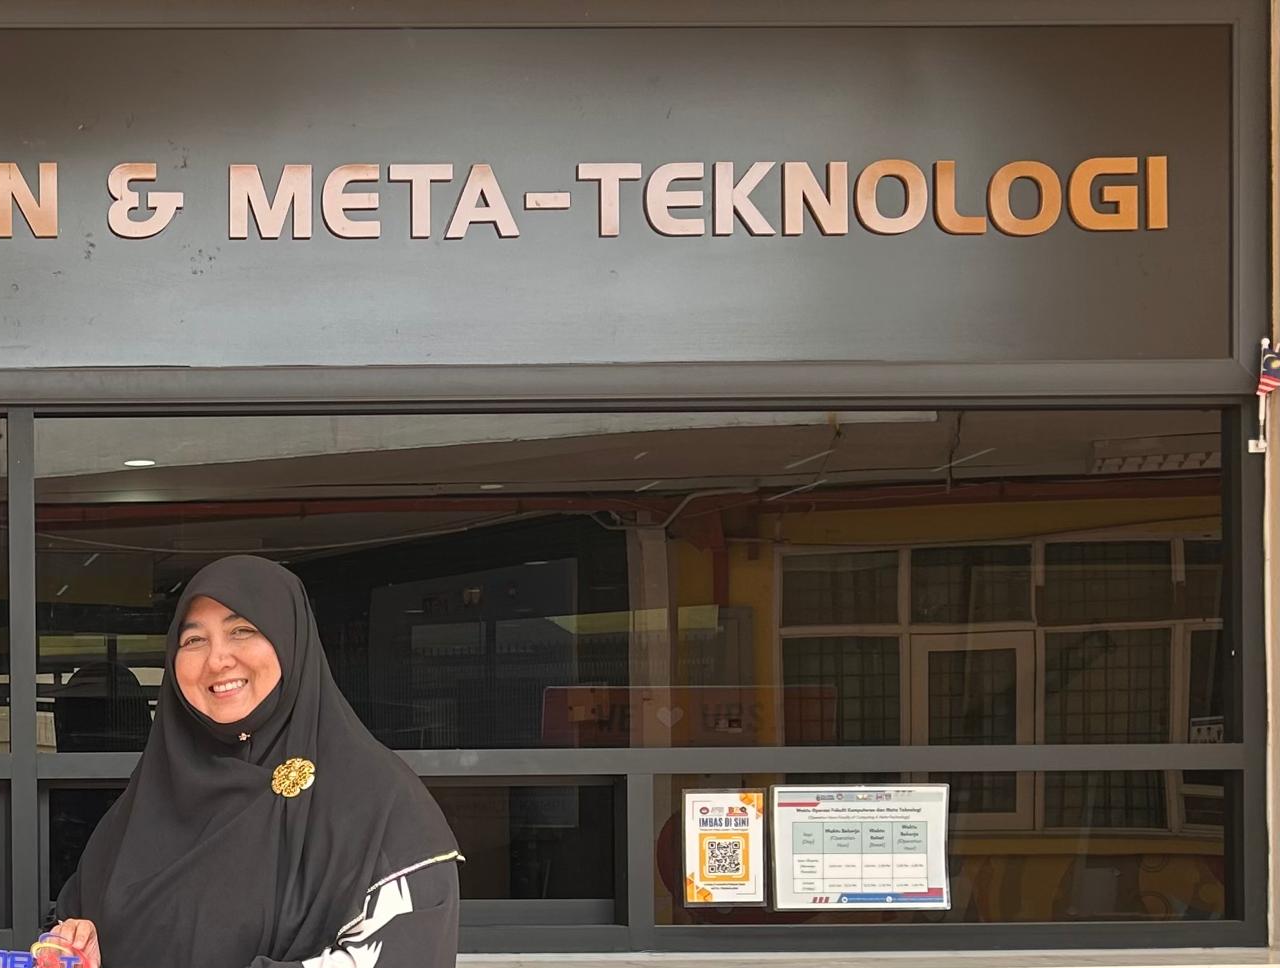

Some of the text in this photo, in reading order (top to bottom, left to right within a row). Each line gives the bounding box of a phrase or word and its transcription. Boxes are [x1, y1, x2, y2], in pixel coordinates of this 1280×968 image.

[106, 162, 184, 240] &
[228, 155, 1169, 240] META-TEKNOLOGI
[699, 817, 749, 827] IMBAS DI SINI
